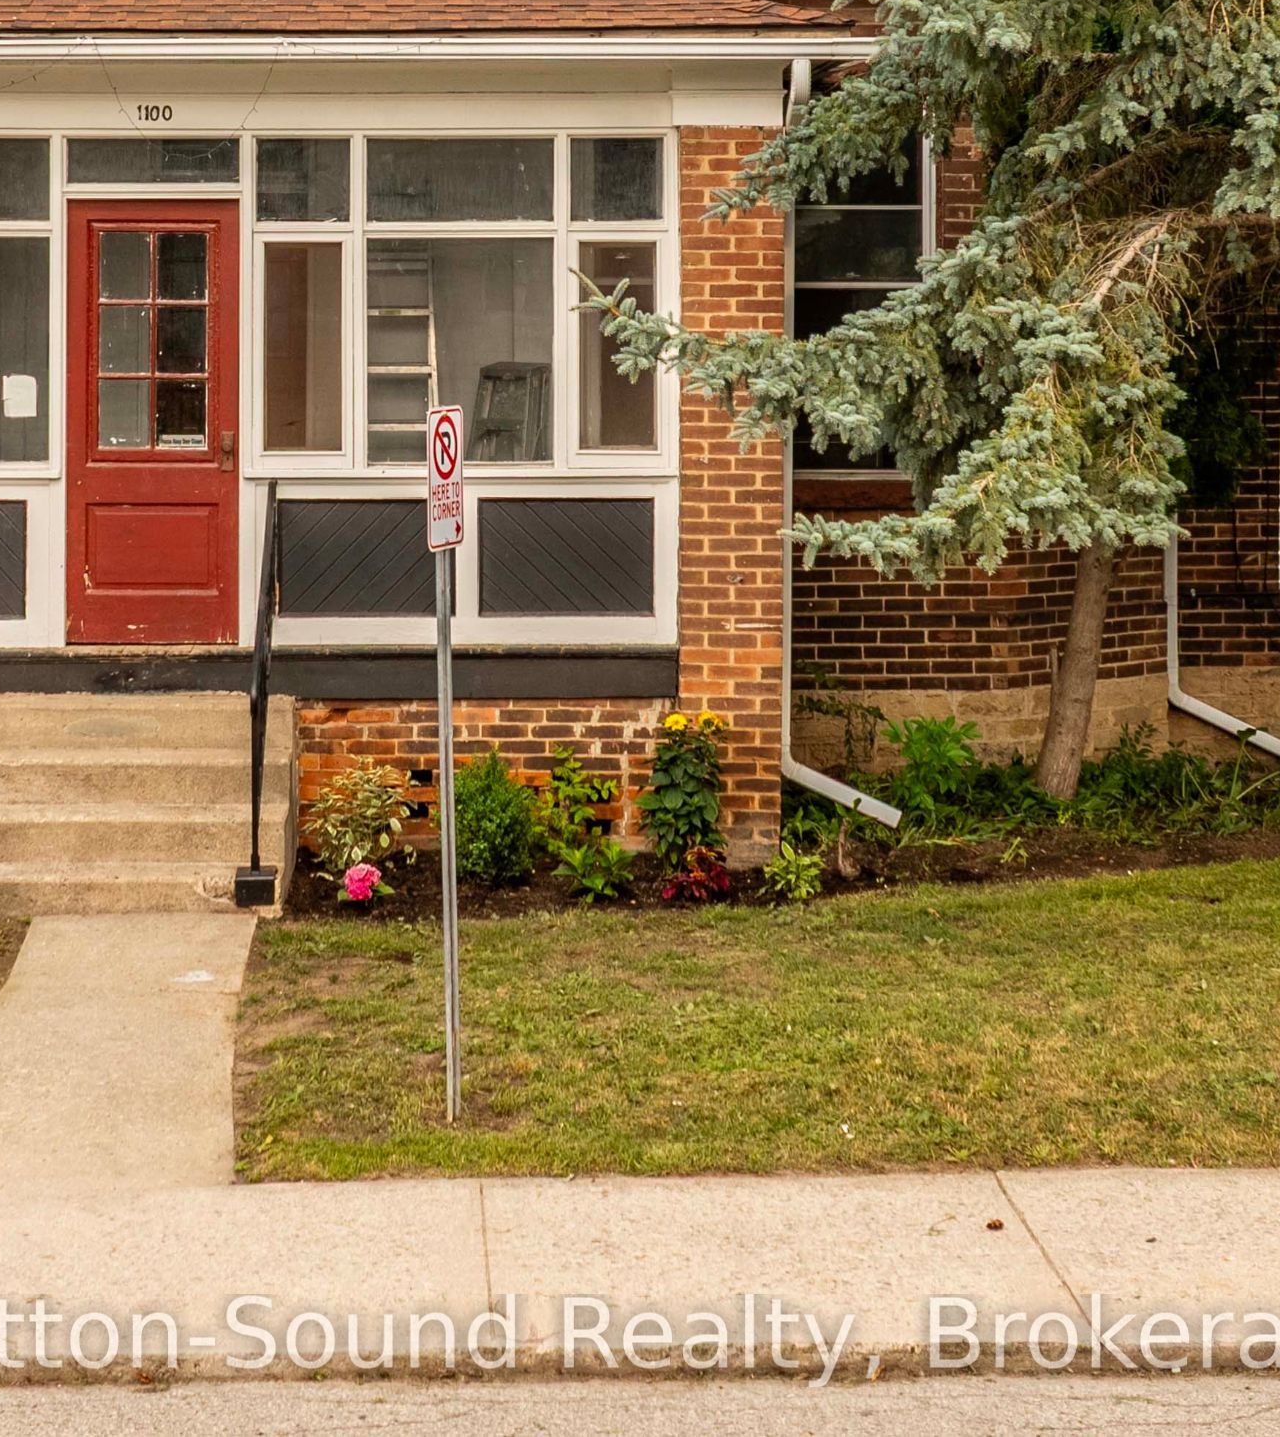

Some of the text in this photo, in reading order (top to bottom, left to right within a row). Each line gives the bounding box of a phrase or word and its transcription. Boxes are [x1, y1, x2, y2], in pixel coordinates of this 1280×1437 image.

[137, 104, 173, 122] 1100
[432, 481, 460, 502] HERE TO
[432, 500, 461, 522] CORNER
